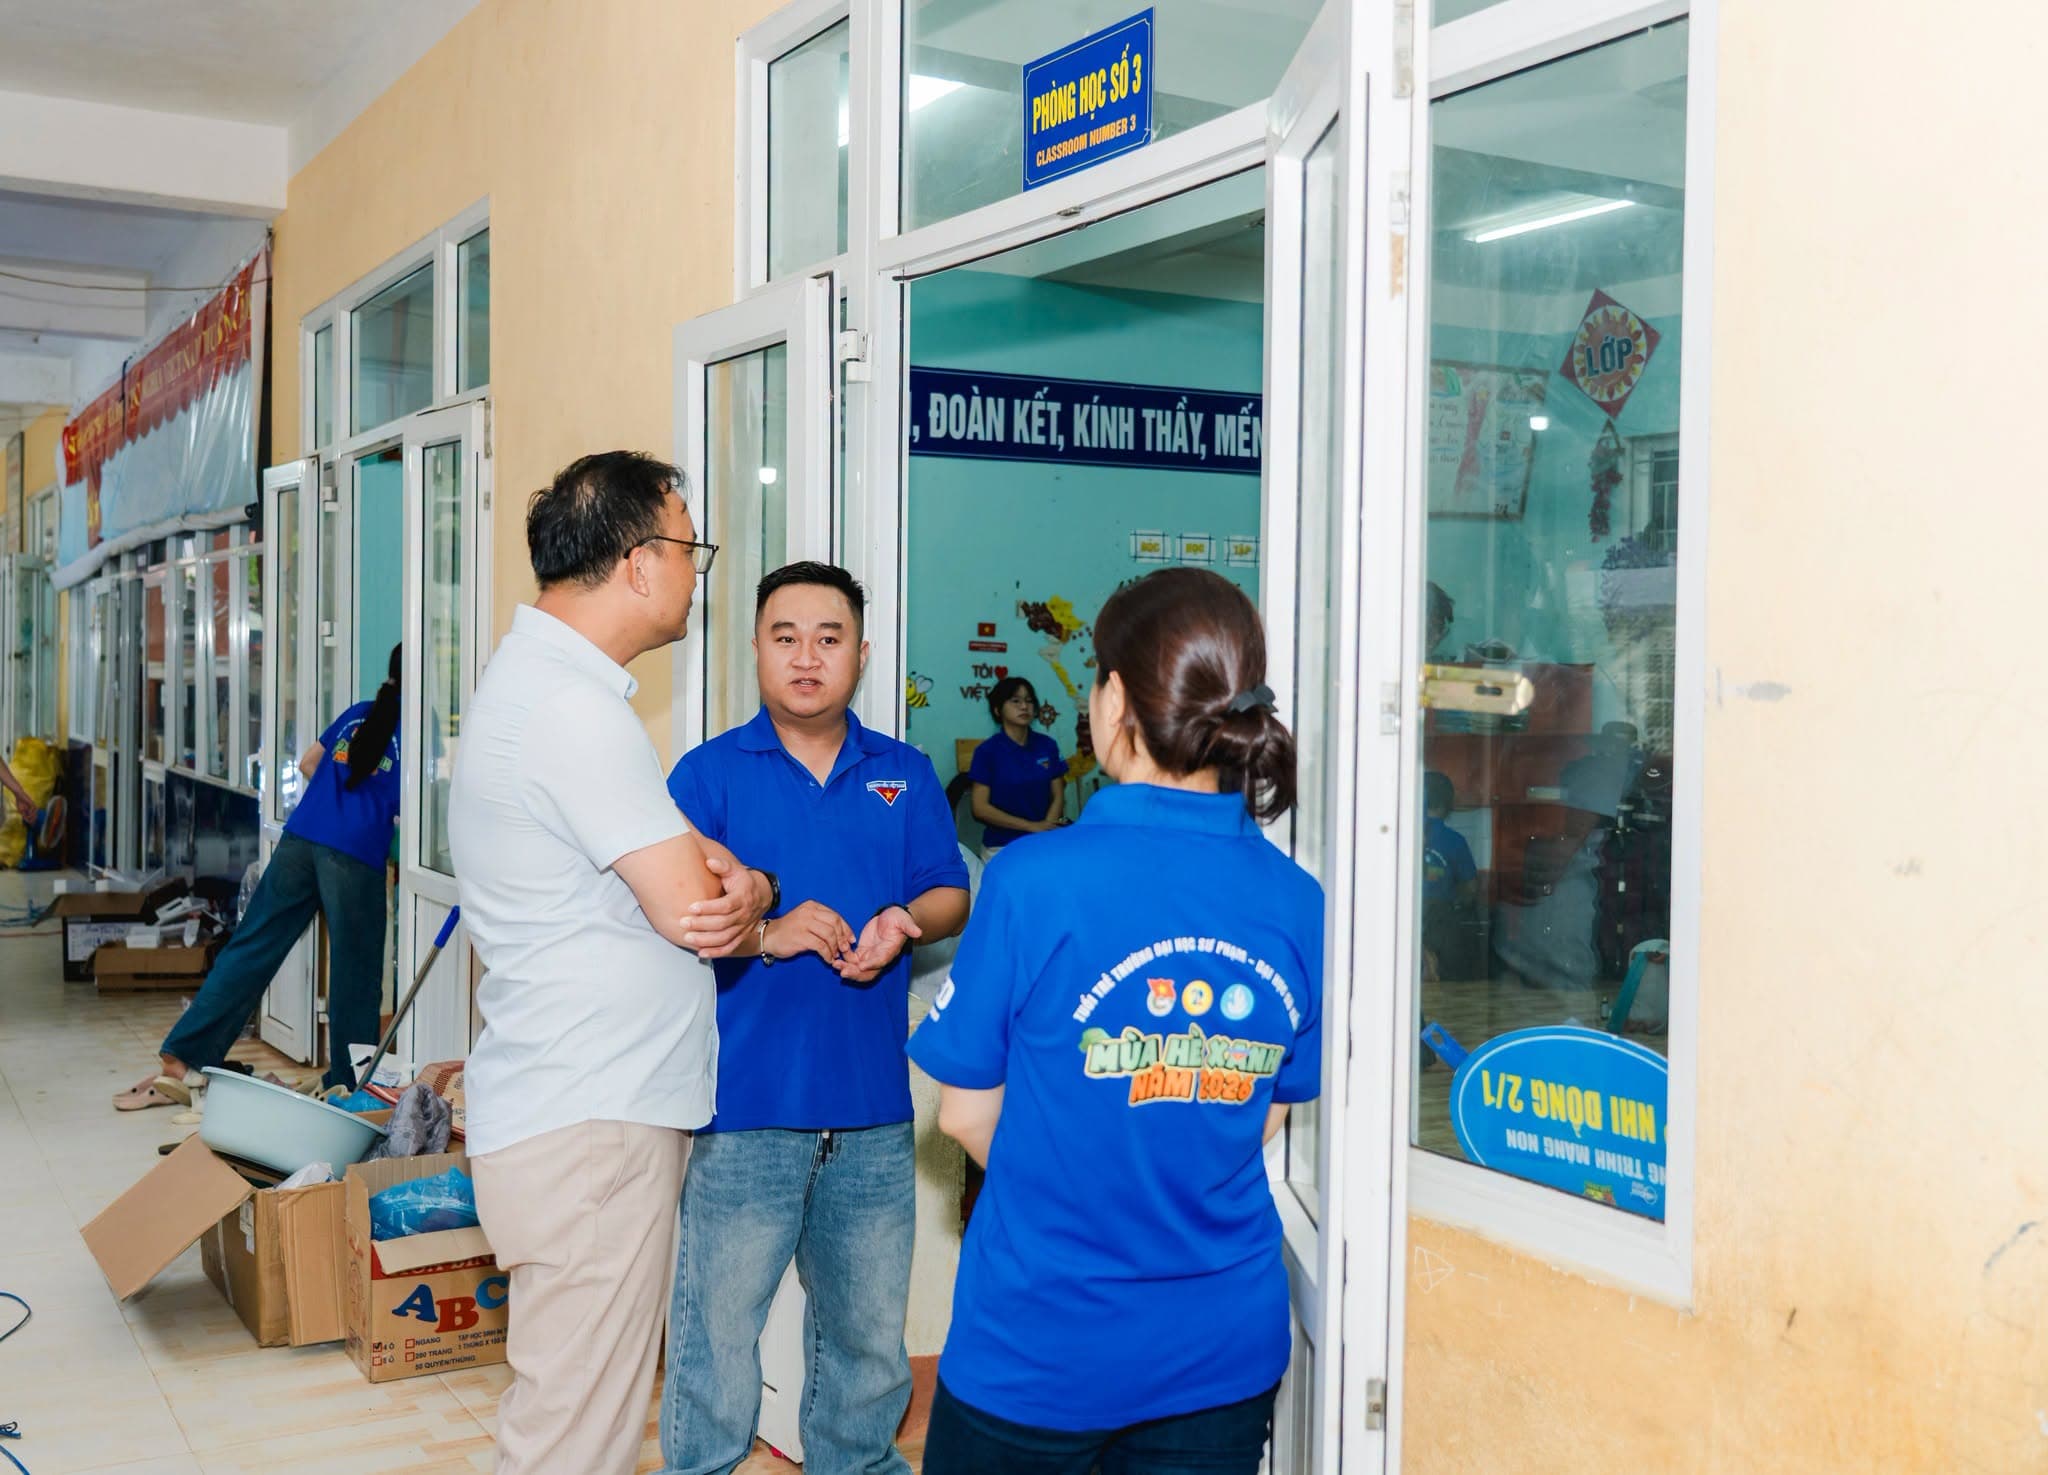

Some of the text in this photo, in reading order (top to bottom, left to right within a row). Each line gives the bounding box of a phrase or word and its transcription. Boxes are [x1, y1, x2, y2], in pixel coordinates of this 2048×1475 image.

[1032, 43, 1142, 135] PHÒNG HỌC SỐ 3
[1036, 113, 1137, 168] CLASSROOM NUMBER 3
[1586, 335, 1633, 377] LỚP
[928, 385, 1005, 443] ĐOÀN
[1013, 386, 1066, 452] KẾT,
[1073, 395, 1135, 451] KÍNH
[1142, 396, 1207, 460] THẦY,
[972, 662, 993, 679] TÔI
[1087, 1025, 1285, 1075] MÙA HÈ XANH
[1131, 1065, 1193, 1104] NĂM
[1481, 1069, 1657, 1145] NHI ĐỒNG 2/1
[1506, 1128, 1540, 1154] NON
[1595, 1148, 1645, 1180] TRÌNH
[416, 1336, 441, 1346] NGANG
[428, 1347, 453, 1357] TRANG
